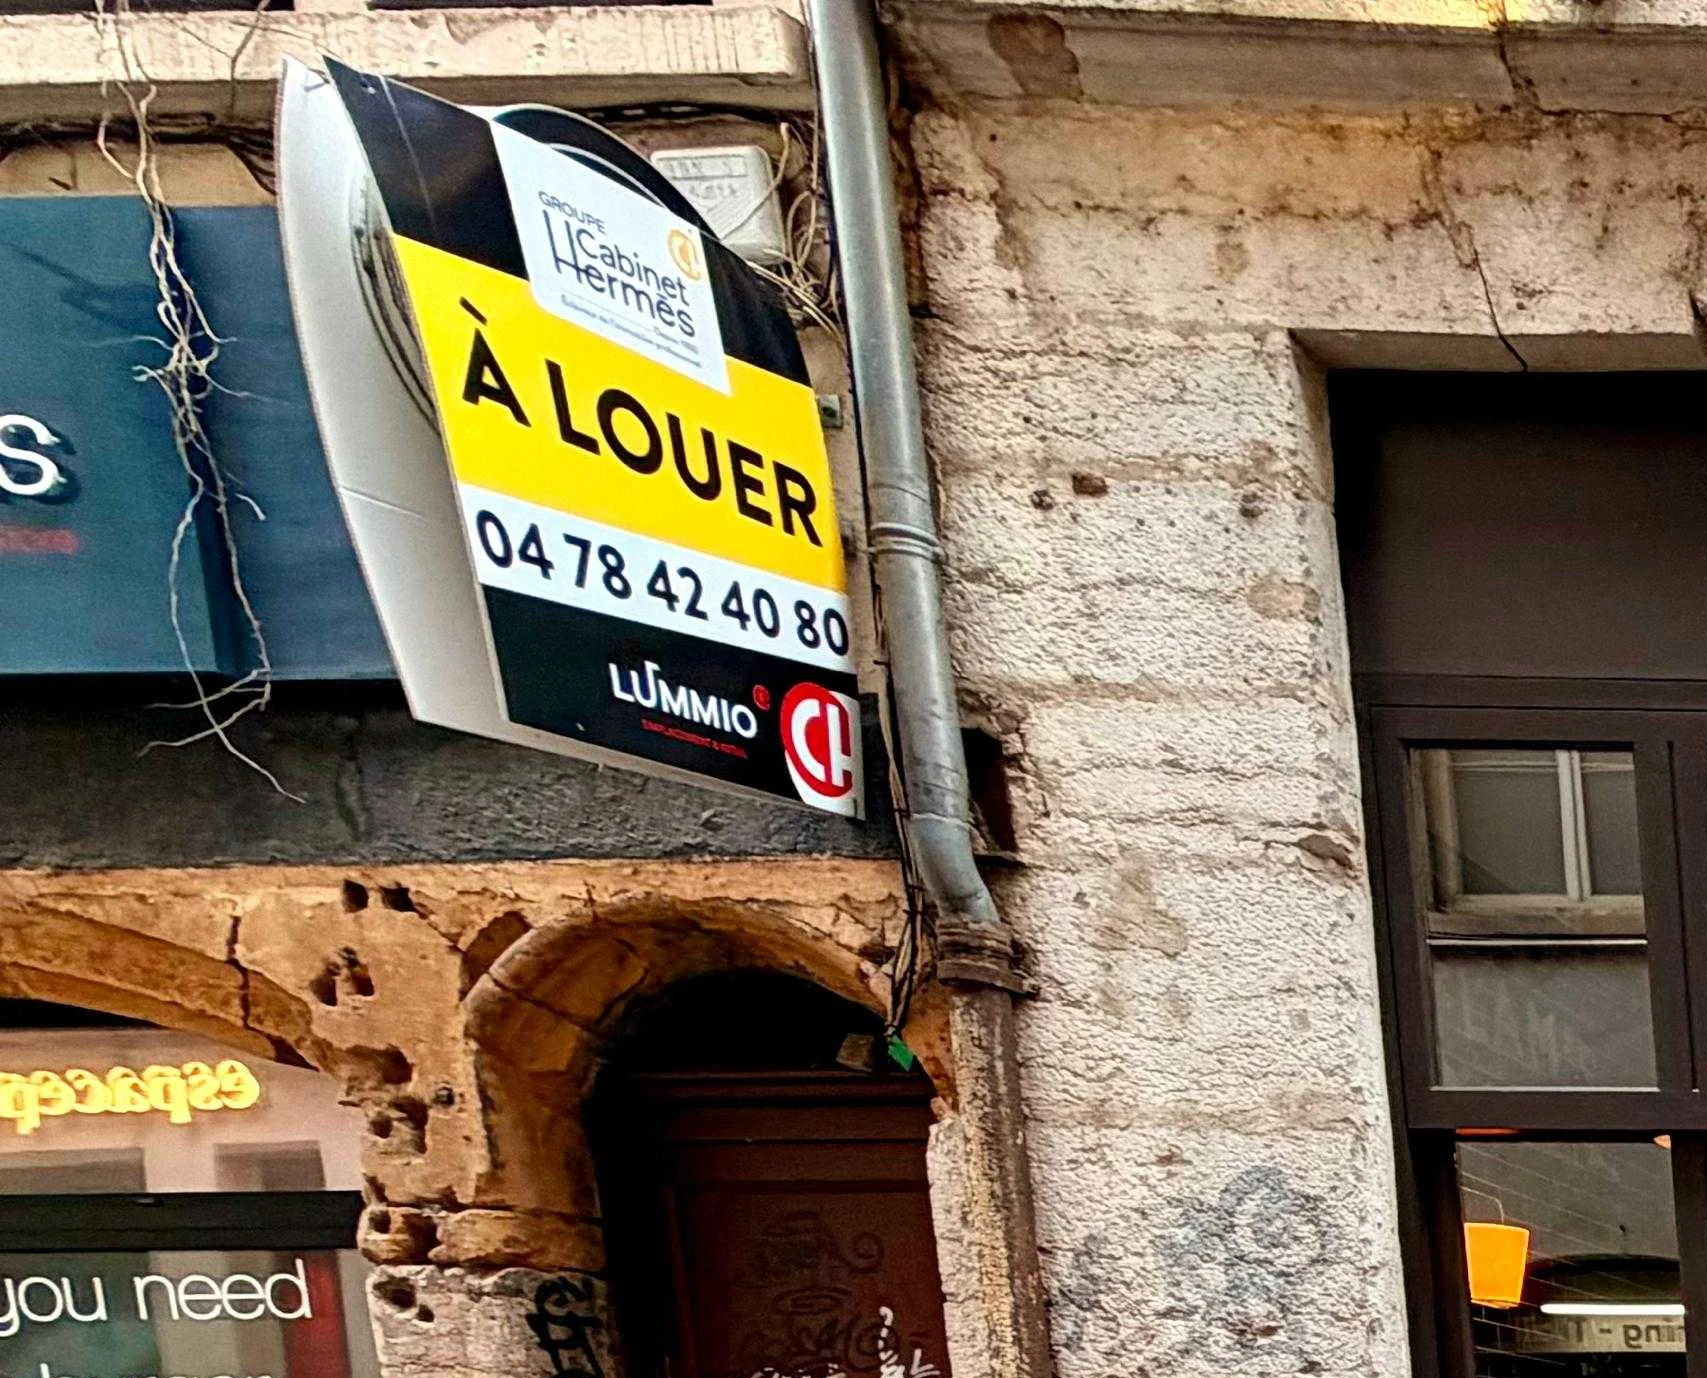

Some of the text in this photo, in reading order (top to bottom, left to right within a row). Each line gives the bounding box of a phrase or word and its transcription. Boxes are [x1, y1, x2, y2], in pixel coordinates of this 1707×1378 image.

[538, 190, 606, 234] GROUPE
[543, 209, 695, 337] Hermès
[576, 227, 690, 306] Cabinet
[460, 297, 531, 427] À
[545, 358, 823, 547] LOUER
[476, 509, 849, 656] 04 78 42 40 80
[608, 660, 758, 738] LUMMIO
[133, 1258, 313, 1320] need
